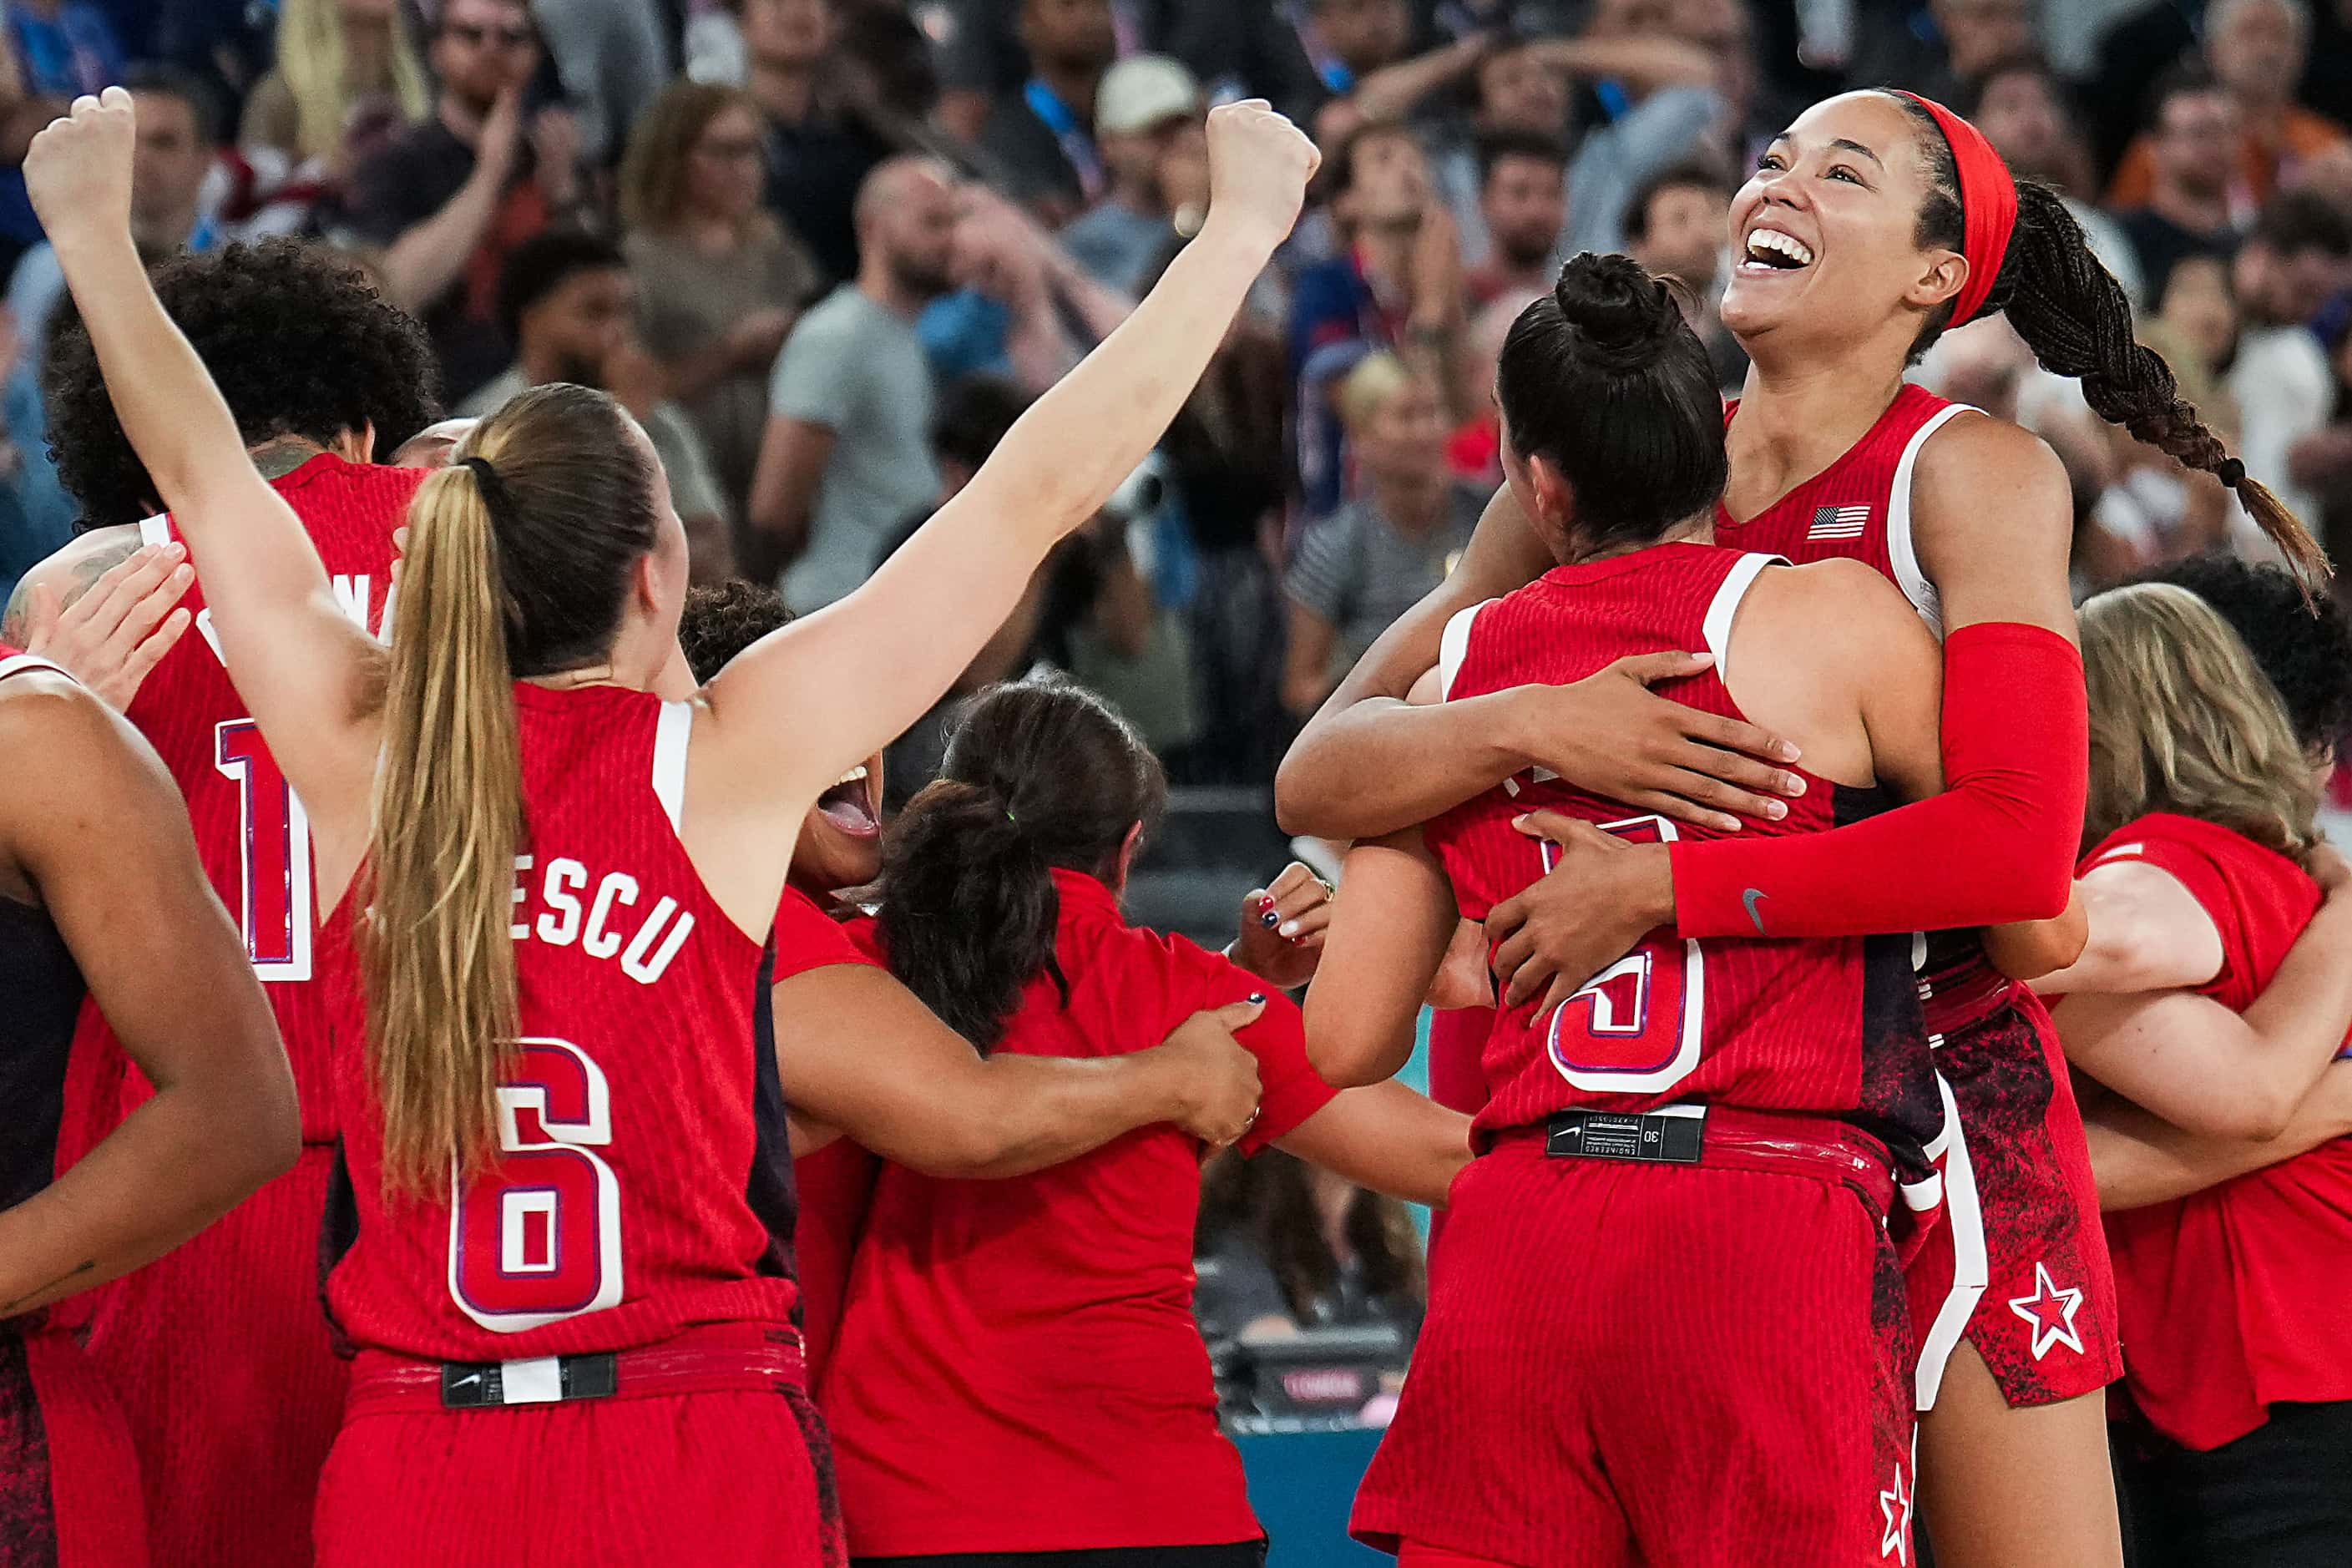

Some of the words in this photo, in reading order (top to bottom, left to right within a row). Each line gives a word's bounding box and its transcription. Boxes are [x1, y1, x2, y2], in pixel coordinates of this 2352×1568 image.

[509, 854, 695, 984] ESCU
[448, 1037, 624, 1334] 6
[1643, 1130, 1660, 1144] 30
